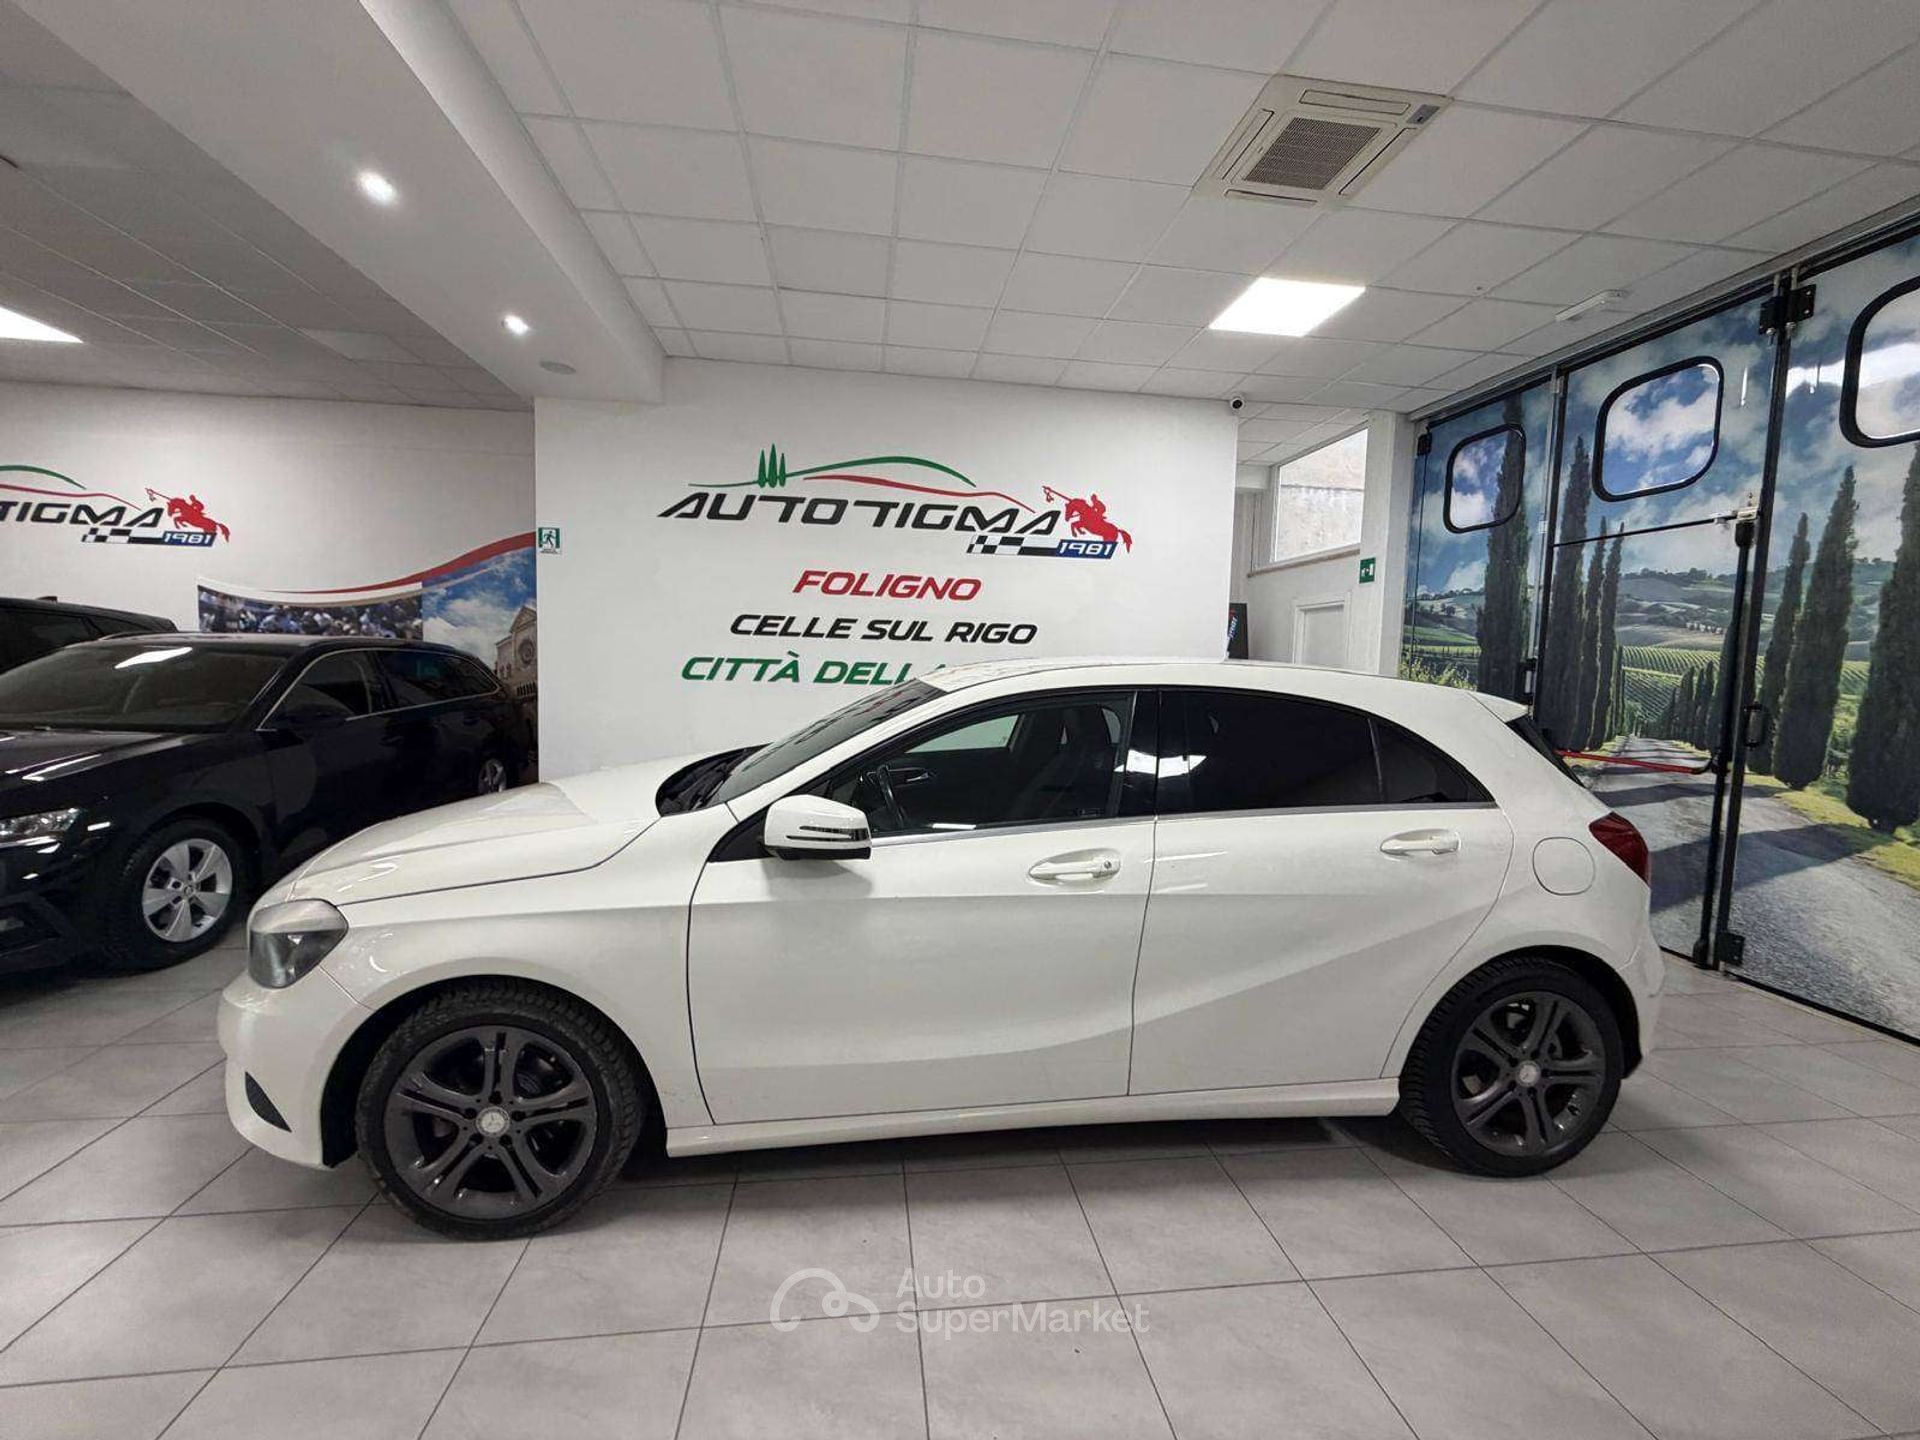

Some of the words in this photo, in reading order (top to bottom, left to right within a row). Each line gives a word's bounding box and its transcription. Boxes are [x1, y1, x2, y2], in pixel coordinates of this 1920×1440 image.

[164, 532, 212, 545] 1981
[1059, 542, 1112, 556] 1981
[792, 570, 982, 602] FOLIGNO
[730, 614, 858, 640] CELLE
[861, 619, 934, 643] SUL
[945, 622, 1038, 645] RIGO
[680, 651, 801, 684] CITTÀ
[813, 660, 946, 686] DELL
